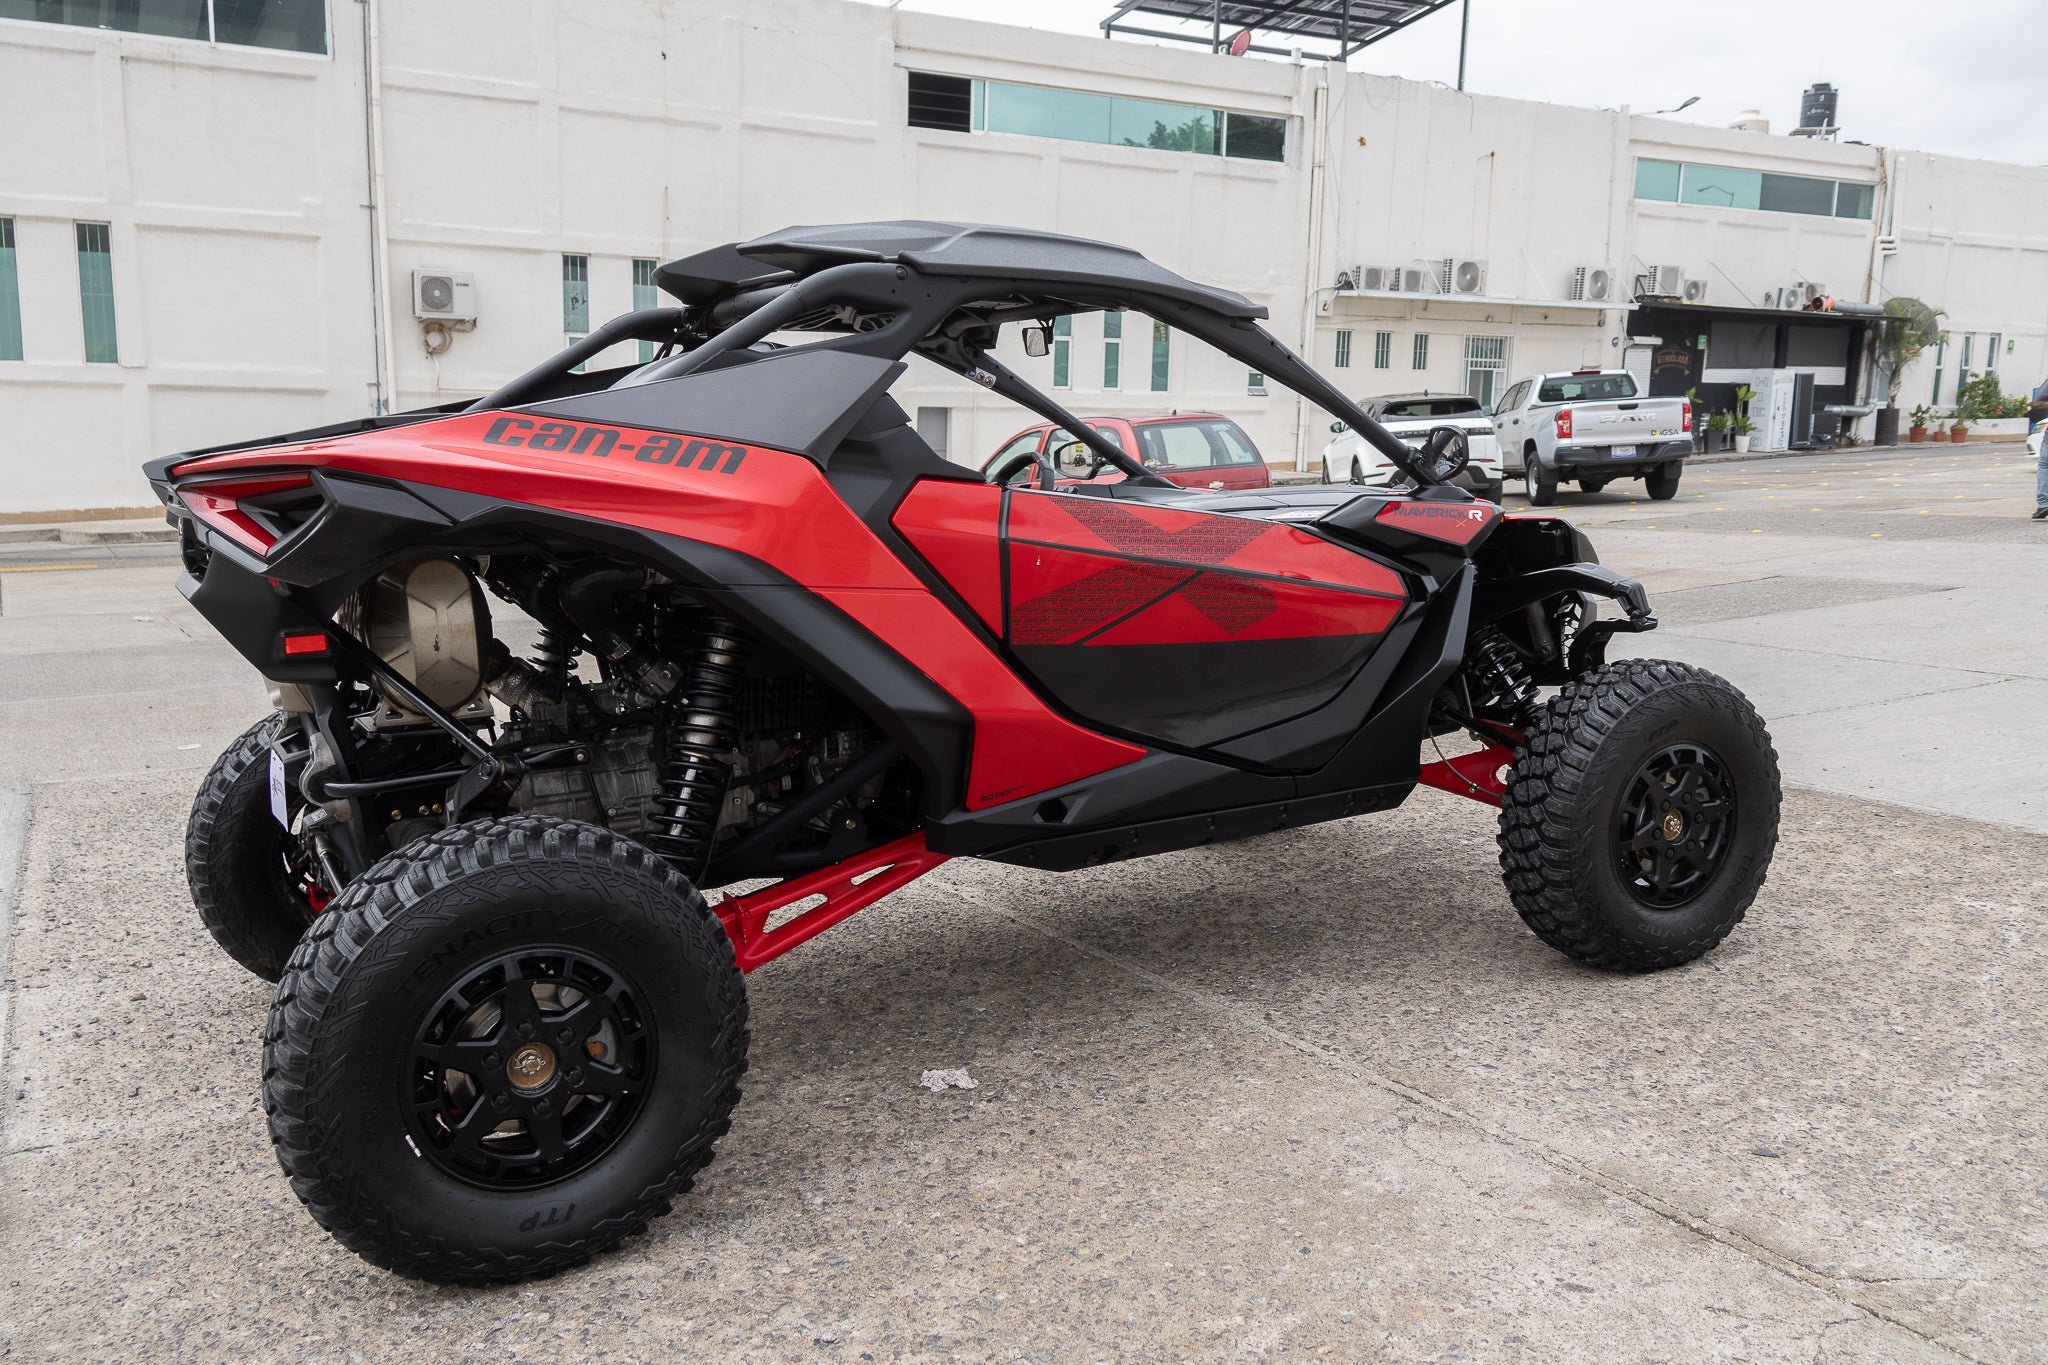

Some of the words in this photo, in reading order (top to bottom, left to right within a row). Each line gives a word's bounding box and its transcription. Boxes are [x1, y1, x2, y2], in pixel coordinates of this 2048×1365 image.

[1599, 413, 1657, 424] RAM
[1650, 428, 1680, 436] DAGSA
[482, 417, 748, 475] can-am
[1393, 506, 1467, 519] MAVERICK
[1468, 509, 1483, 521] R
[394, 908, 570, 997] TENACITY
[518, 1203, 576, 1233] ITP
